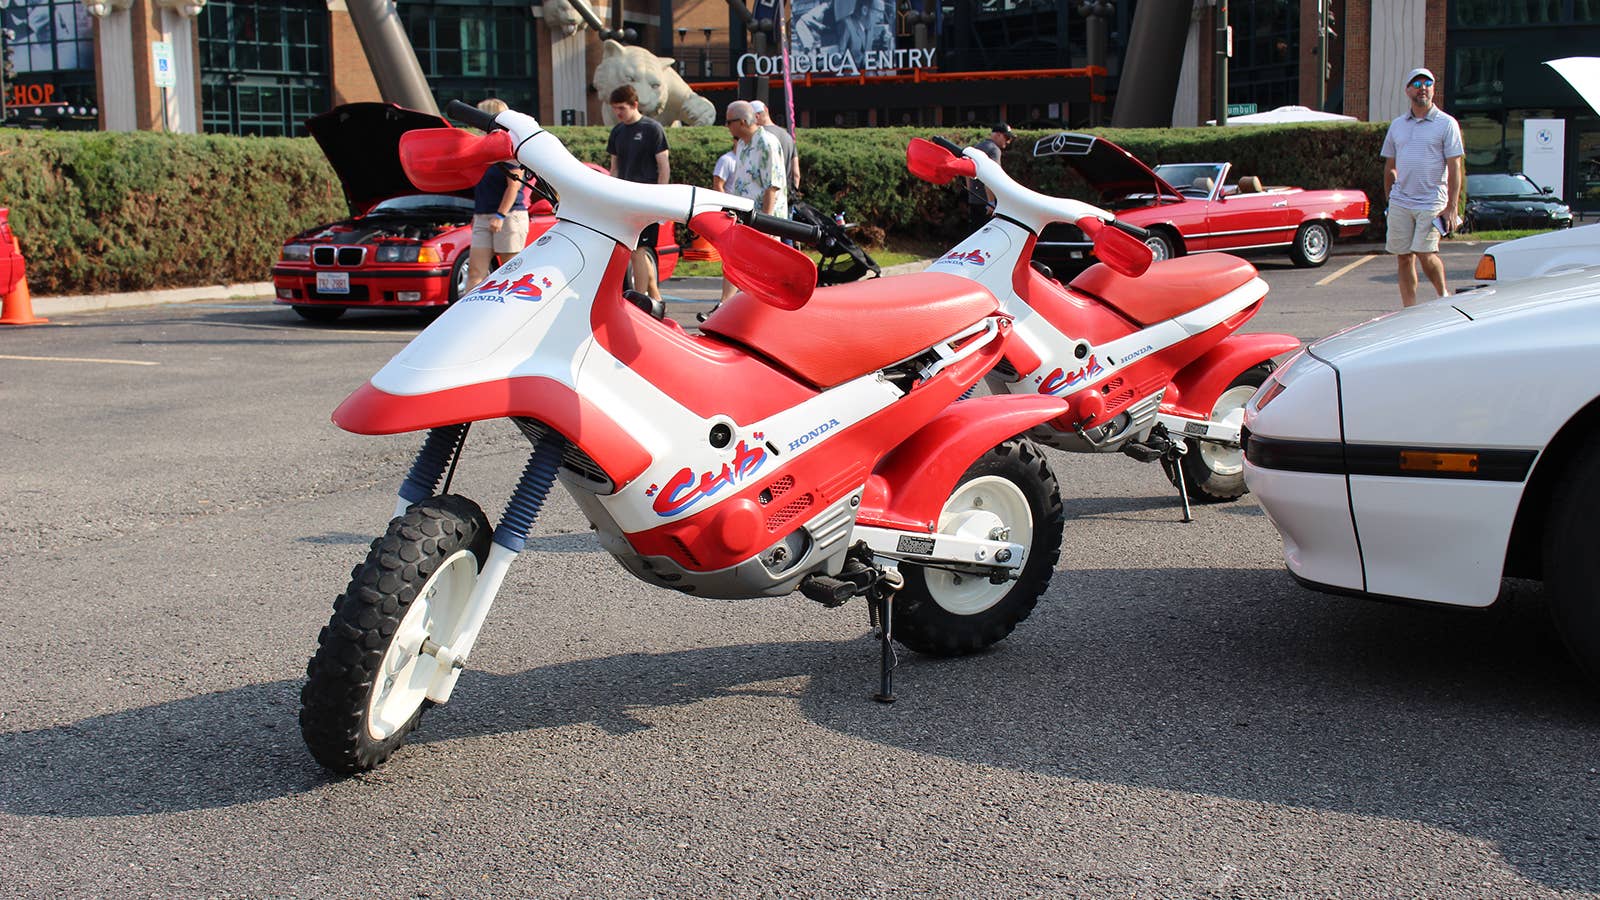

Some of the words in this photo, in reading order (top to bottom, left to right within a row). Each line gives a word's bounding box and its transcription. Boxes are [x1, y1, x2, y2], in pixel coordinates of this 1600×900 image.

[865, 48, 936, 70] ENTRY
[462, 295, 506, 304] HONDA
[1120, 344, 1153, 364] HONDA
[788, 418, 841, 452] HONDA
